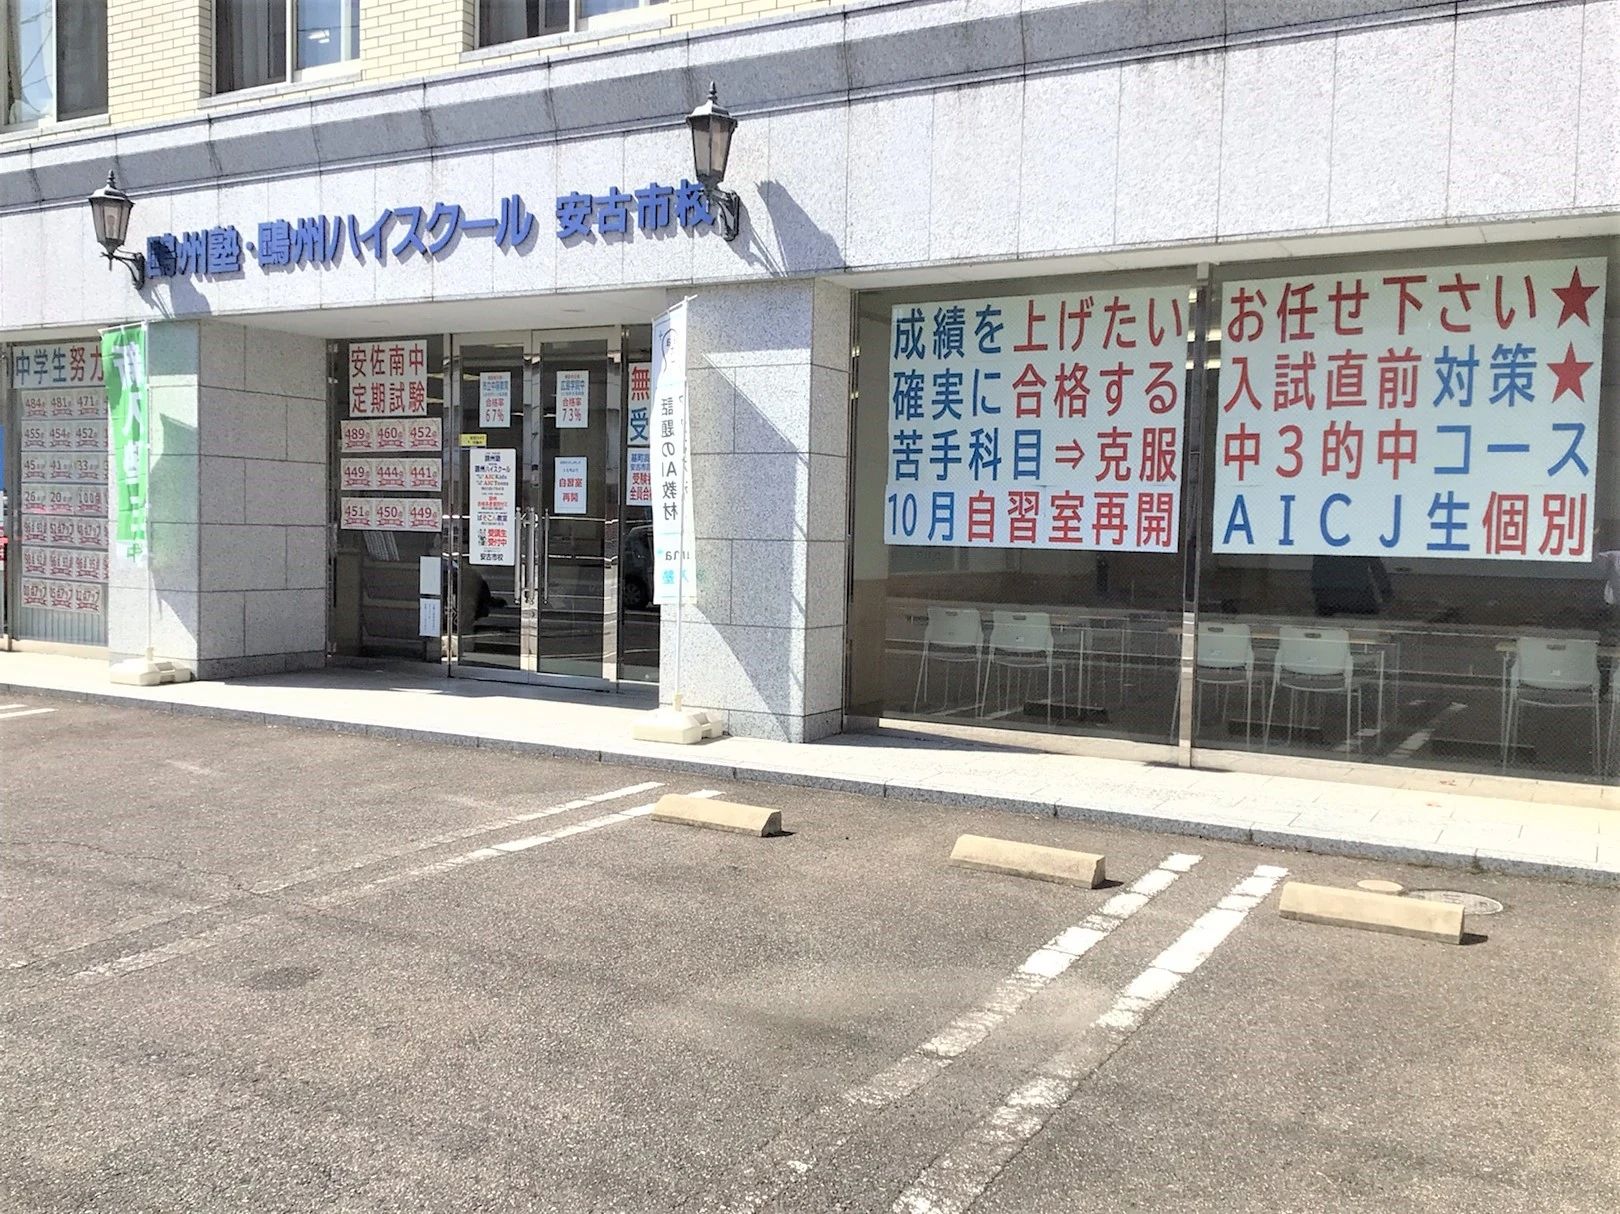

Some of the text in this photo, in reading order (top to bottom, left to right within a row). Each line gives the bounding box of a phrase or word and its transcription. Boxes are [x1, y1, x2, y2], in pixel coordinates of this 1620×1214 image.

[556, 178, 715, 239] 安古市校
[893, 295, 1182, 359] 成績を上げたい
[1227, 274, 1538, 345] お任せ下さい
[351, 343, 424, 378] 安佐南中
[1223, 342, 1537, 414] 入試直前対策
[352, 380, 425, 413] 定期試験
[892, 361, 1179, 422] 確実に合格する
[633, 472, 650, 485] 受験
[1223, 419, 1590, 481] 中3的中コース
[559, 477, 583, 487] 自習室
[630, 486, 651, 500] 全員合
[887, 490, 1175, 547] 10月自習室再開
[1225, 491, 1588, 557] AICJ生個別
